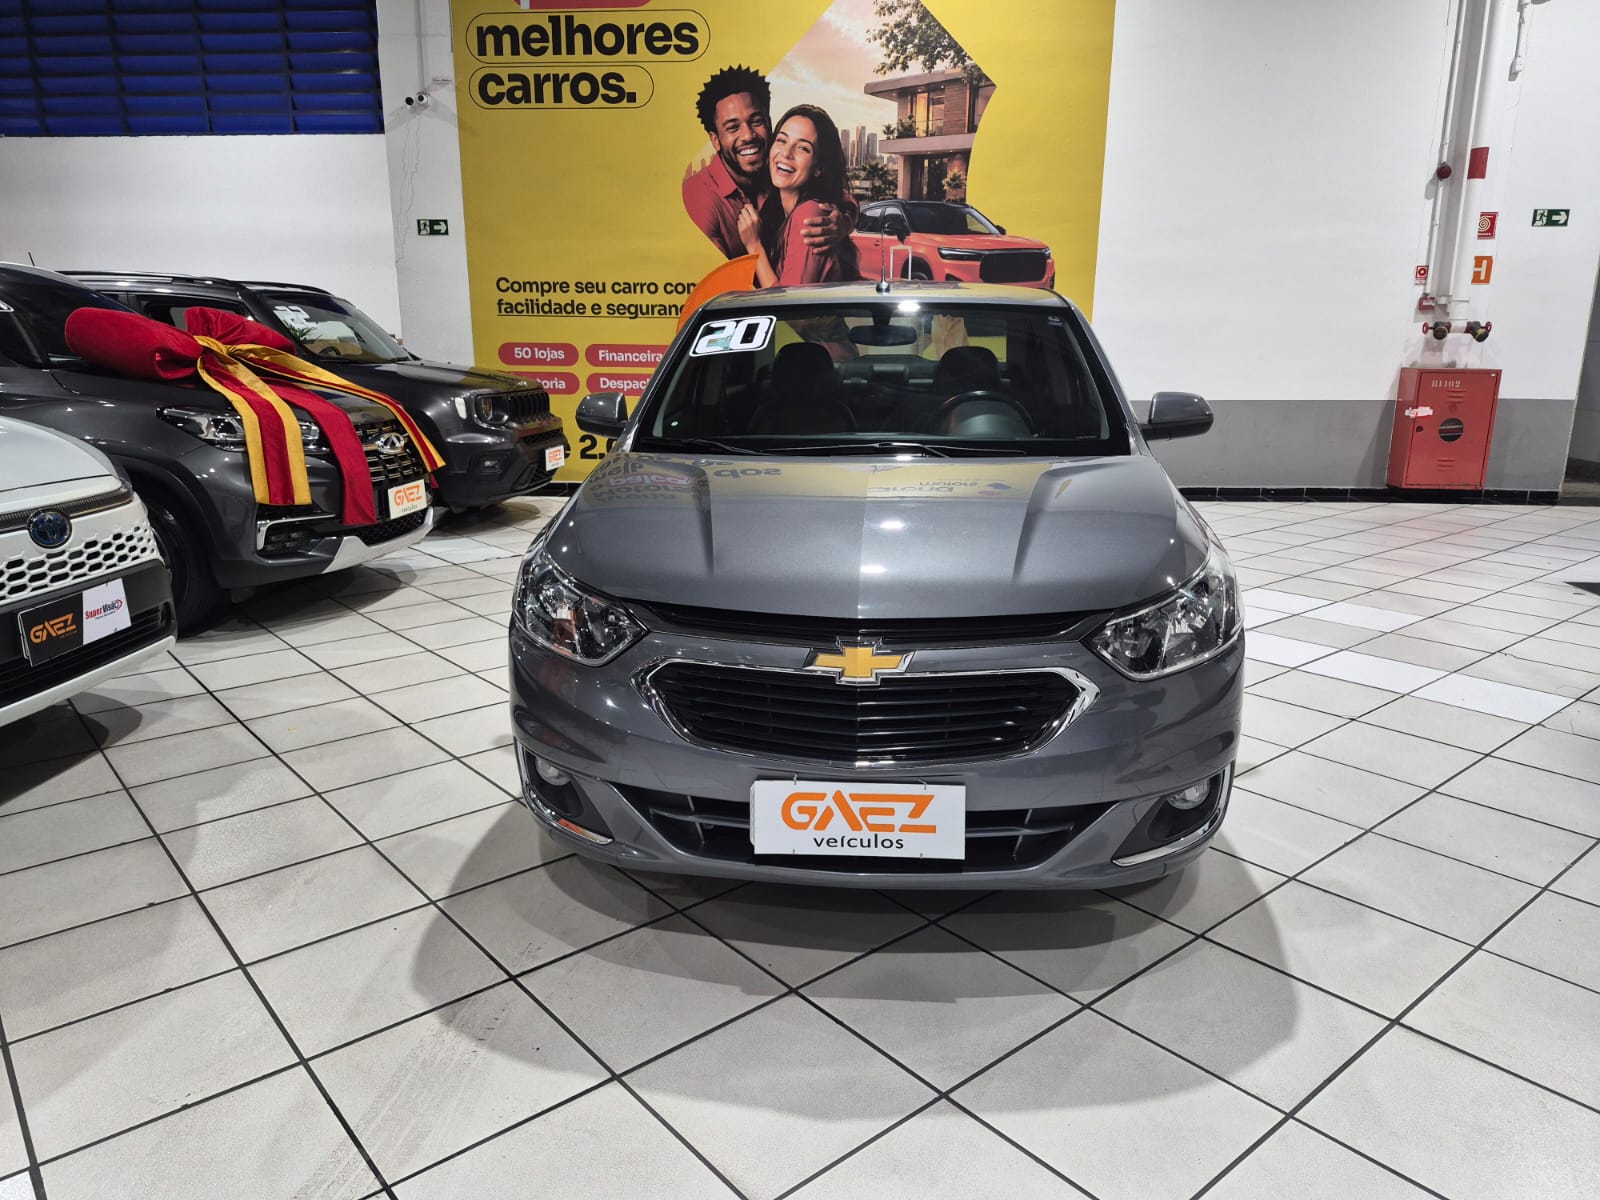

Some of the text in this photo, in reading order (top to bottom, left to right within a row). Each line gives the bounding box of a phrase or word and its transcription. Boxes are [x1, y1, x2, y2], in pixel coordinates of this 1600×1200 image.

[476, 15, 699, 57] melhores
[478, 72, 637, 105] carros.
[496, 277, 570, 296] Compre
[574, 281, 606, 294] seu
[611, 281, 659, 295] carro
[497, 299, 586, 315] facilidade
[591, 303, 602, 315] e
[695, 318, 770, 353] 20
[514, 347, 565, 361] 50 lojas
[599, 350, 663, 362] Financeira
[30, 613, 77, 644] GAEZ
[781, 789, 937, 833] GAEZ
[813, 833, 904, 849] veículos
